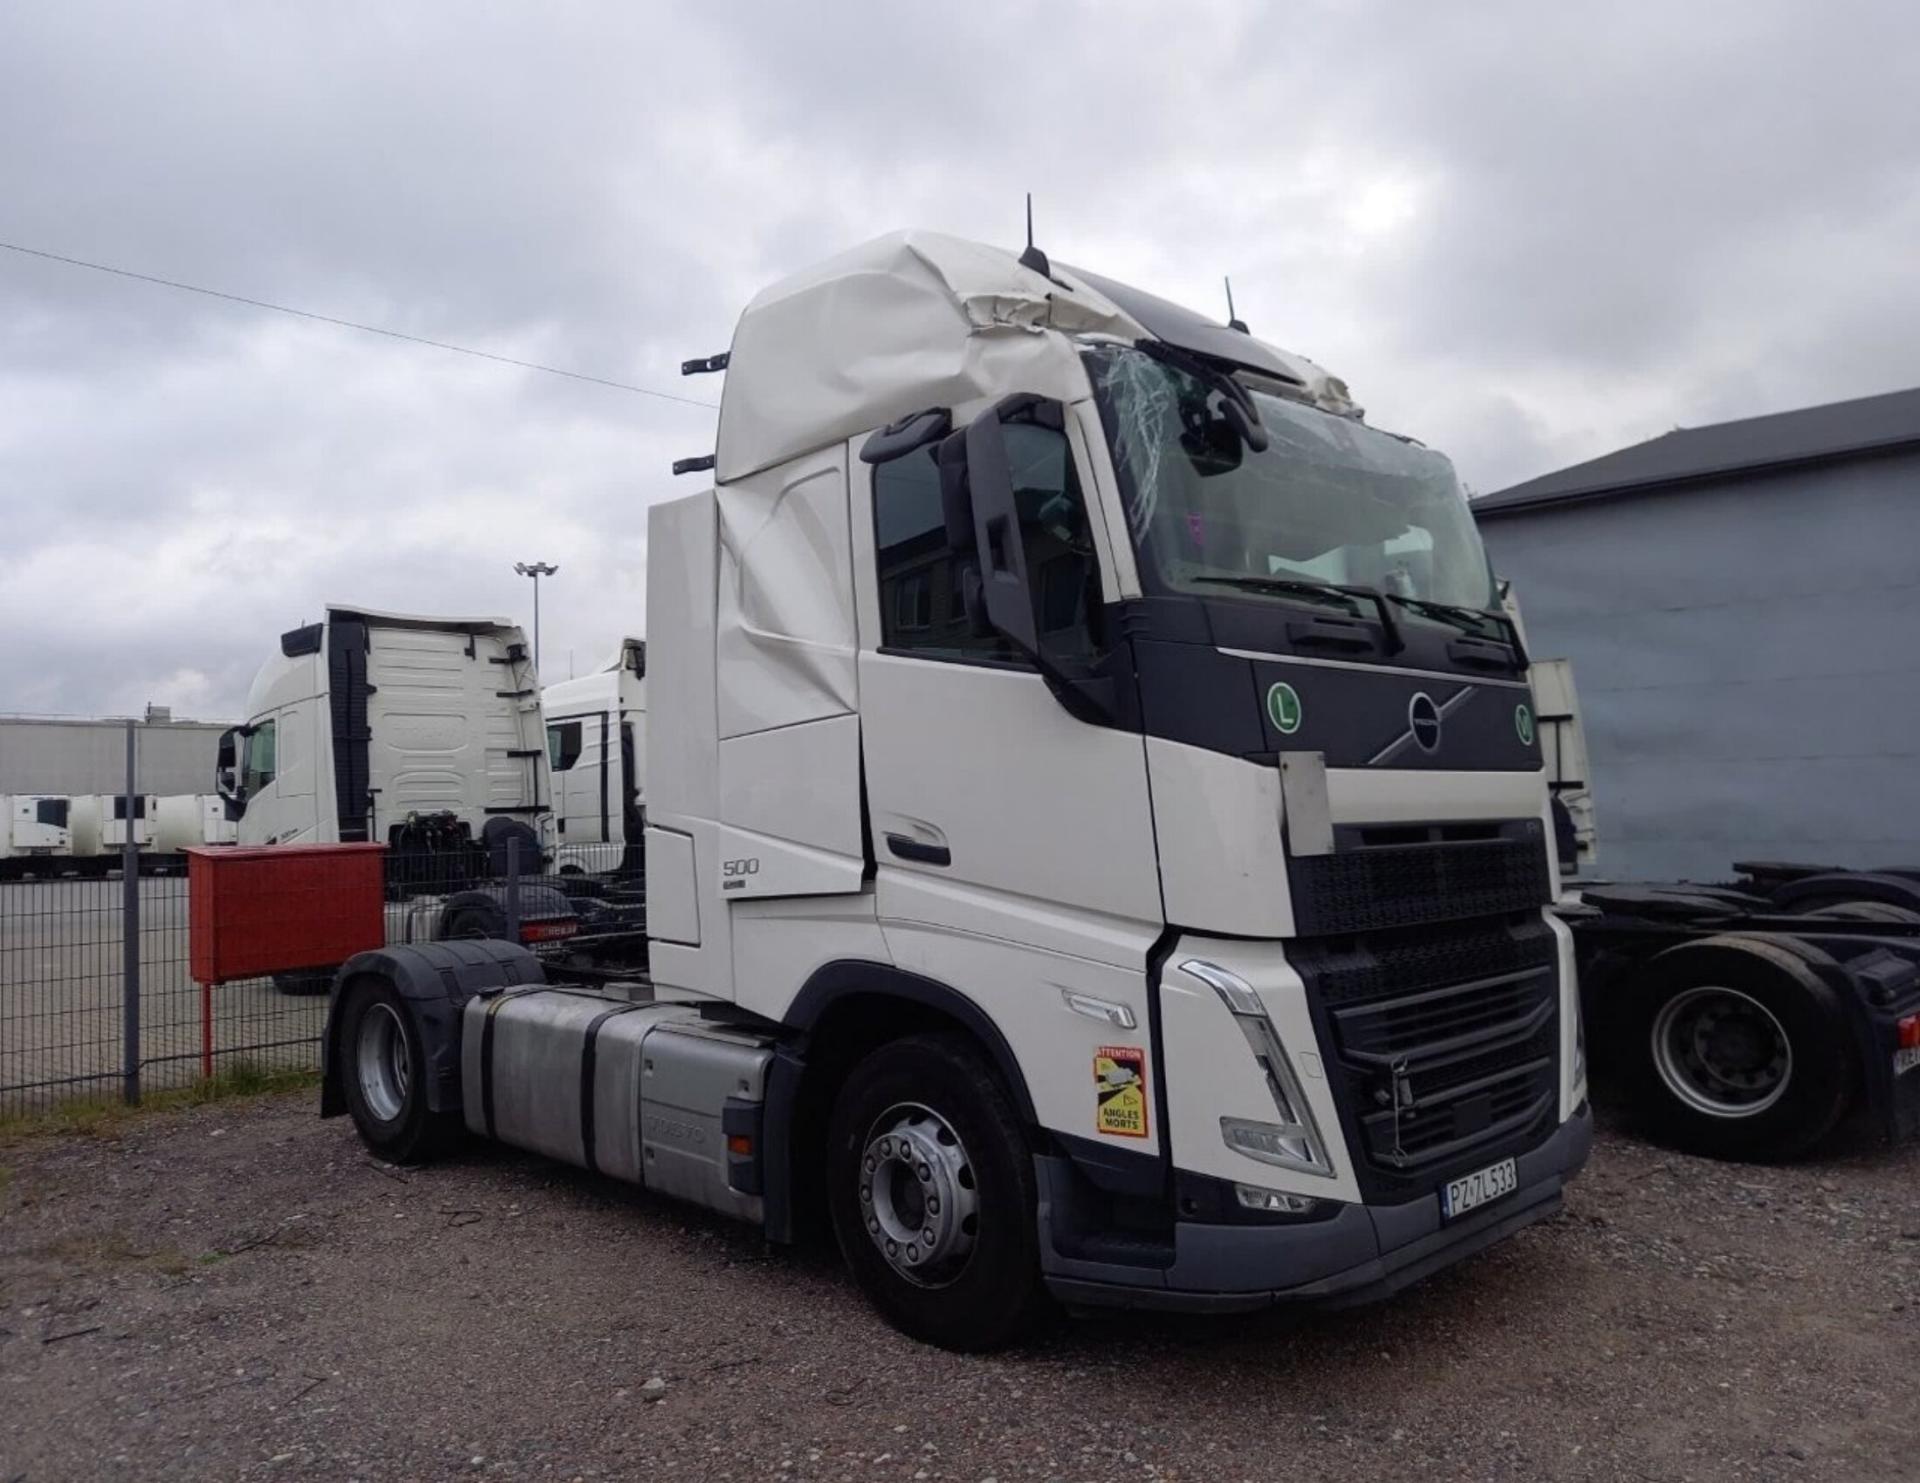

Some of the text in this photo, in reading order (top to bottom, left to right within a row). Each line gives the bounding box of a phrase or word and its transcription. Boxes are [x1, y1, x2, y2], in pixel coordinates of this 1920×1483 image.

[1276, 693, 1294, 724] L
[723, 858, 759, 876] 500
[1103, 1107, 1139, 1119] ANGLES
[1104, 1118, 1138, 1130] MORTS
